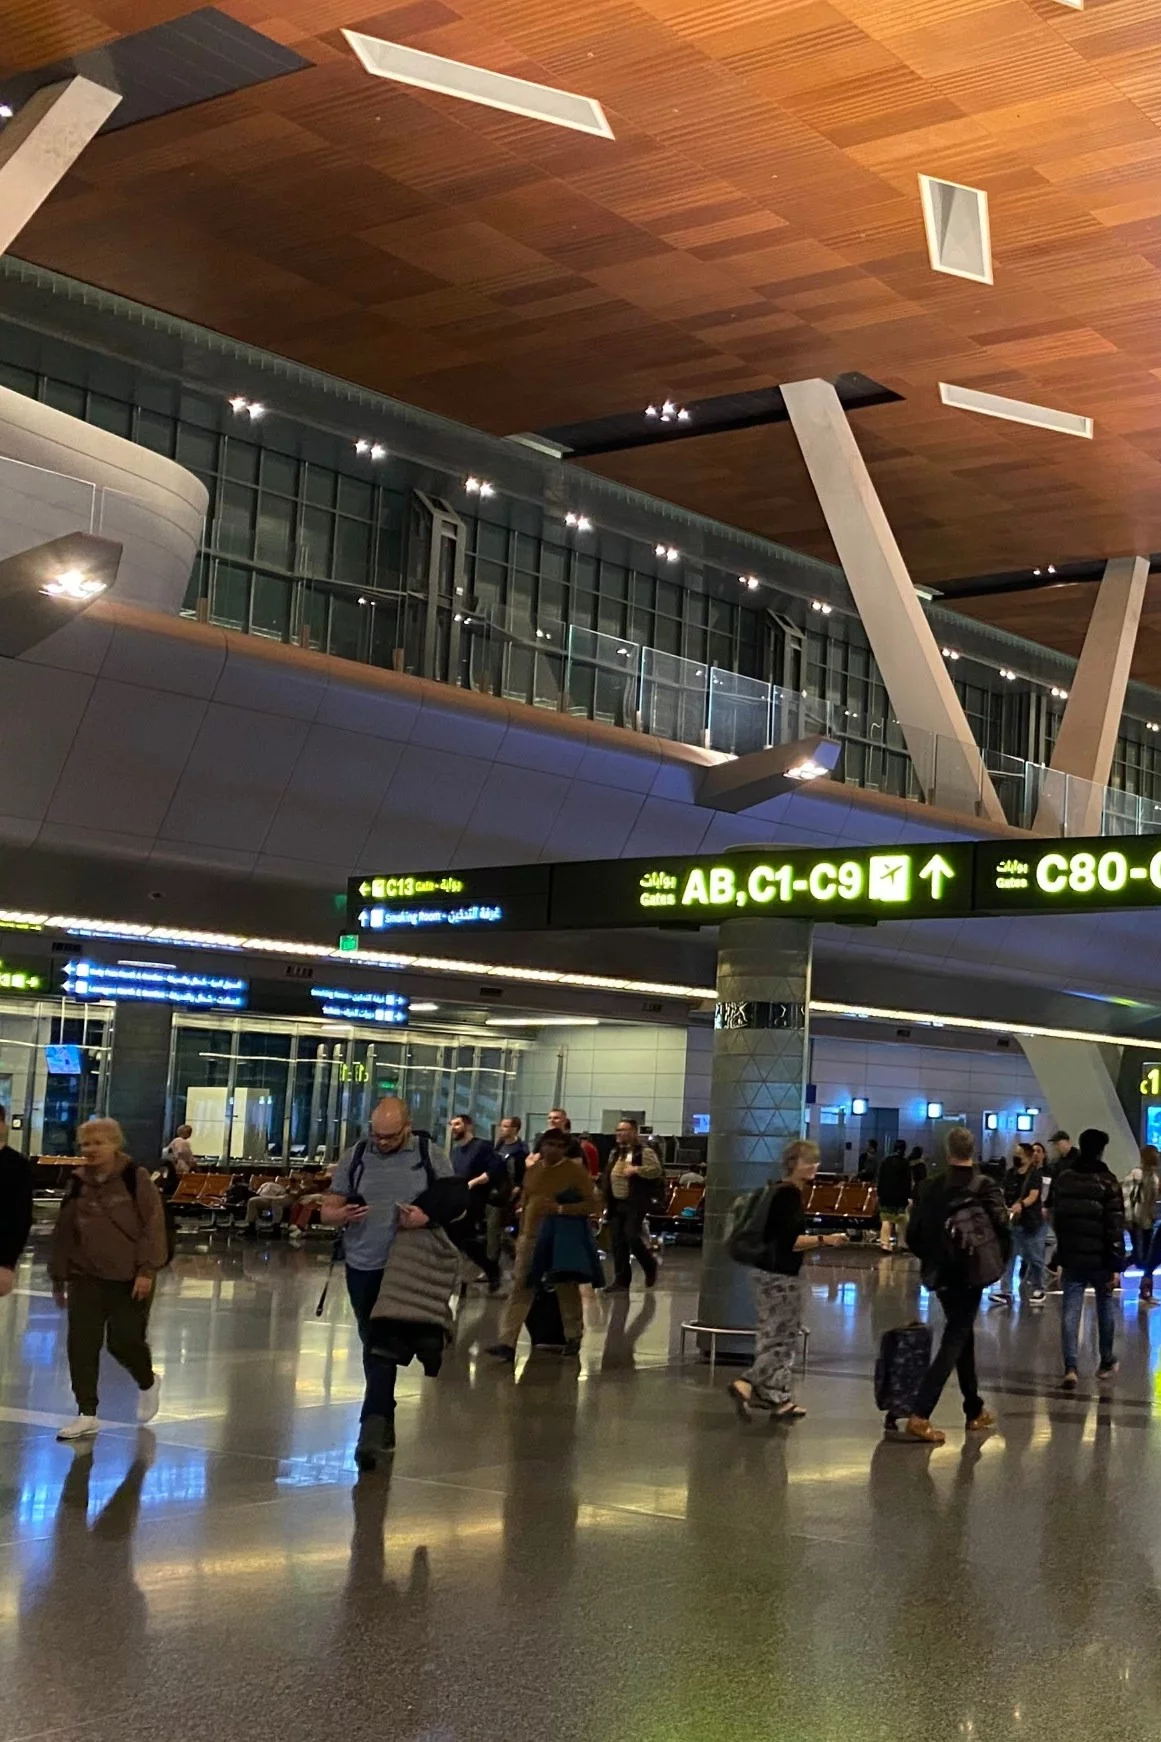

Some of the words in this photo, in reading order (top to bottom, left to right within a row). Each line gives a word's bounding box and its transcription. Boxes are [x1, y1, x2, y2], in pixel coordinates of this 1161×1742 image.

[996, 859, 1028, 874] بوابات
[386, 878, 414, 896] C13
[415, 881, 434, 892] Gate
[441, 877, 463, 892] بوابة
[640, 871, 677, 889] بوابات
[681, 861, 863, 907] AB,C1-C9
[996, 877, 1028, 889] Gates
[640, 892, 676, 907] Gates
[385, 911, 418, 925] Smoking
[418, 911, 441, 922] Room
